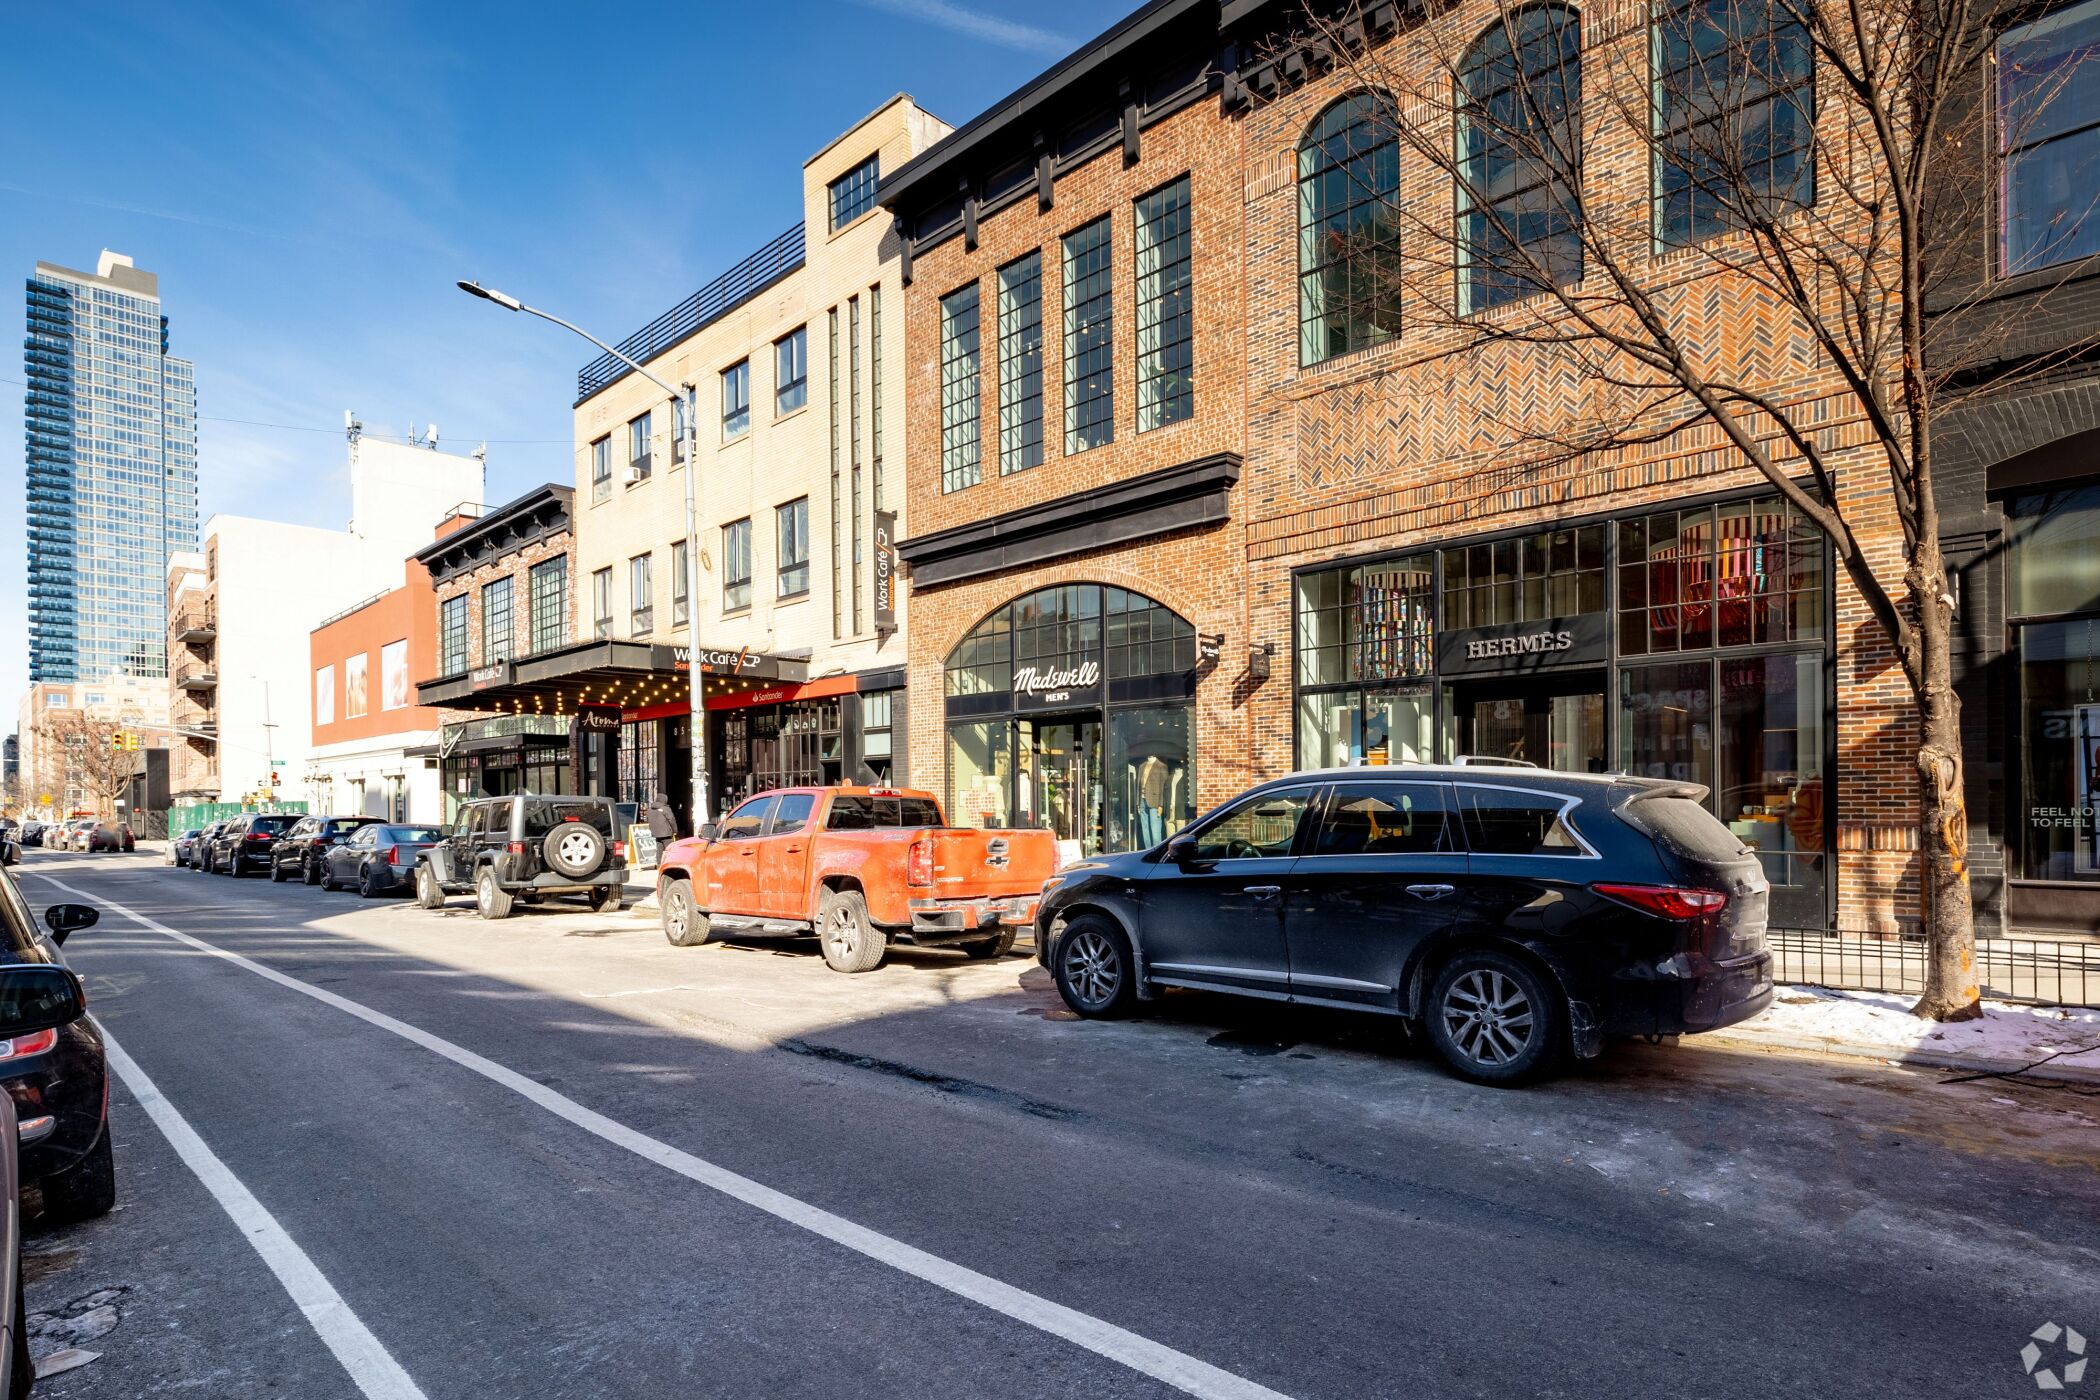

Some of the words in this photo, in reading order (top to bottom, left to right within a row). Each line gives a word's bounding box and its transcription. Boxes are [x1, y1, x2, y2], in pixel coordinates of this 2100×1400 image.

[877, 550, 888, 579] Café
[877, 579, 888, 611] Work
[1467, 631, 1571, 659] HERMÈS
[709, 651, 738, 666] Café
[1013, 661, 1100, 697] Madewell
[758, 691, 783, 702] Santander
[1045, 691, 1070, 703] MEN'S
[581, 711, 619, 727] Aroma
[2031, 807, 2066, 817] FEEL
[2031, 818, 2051, 828] TO
[2054, 818, 2091, 828] FEEL
